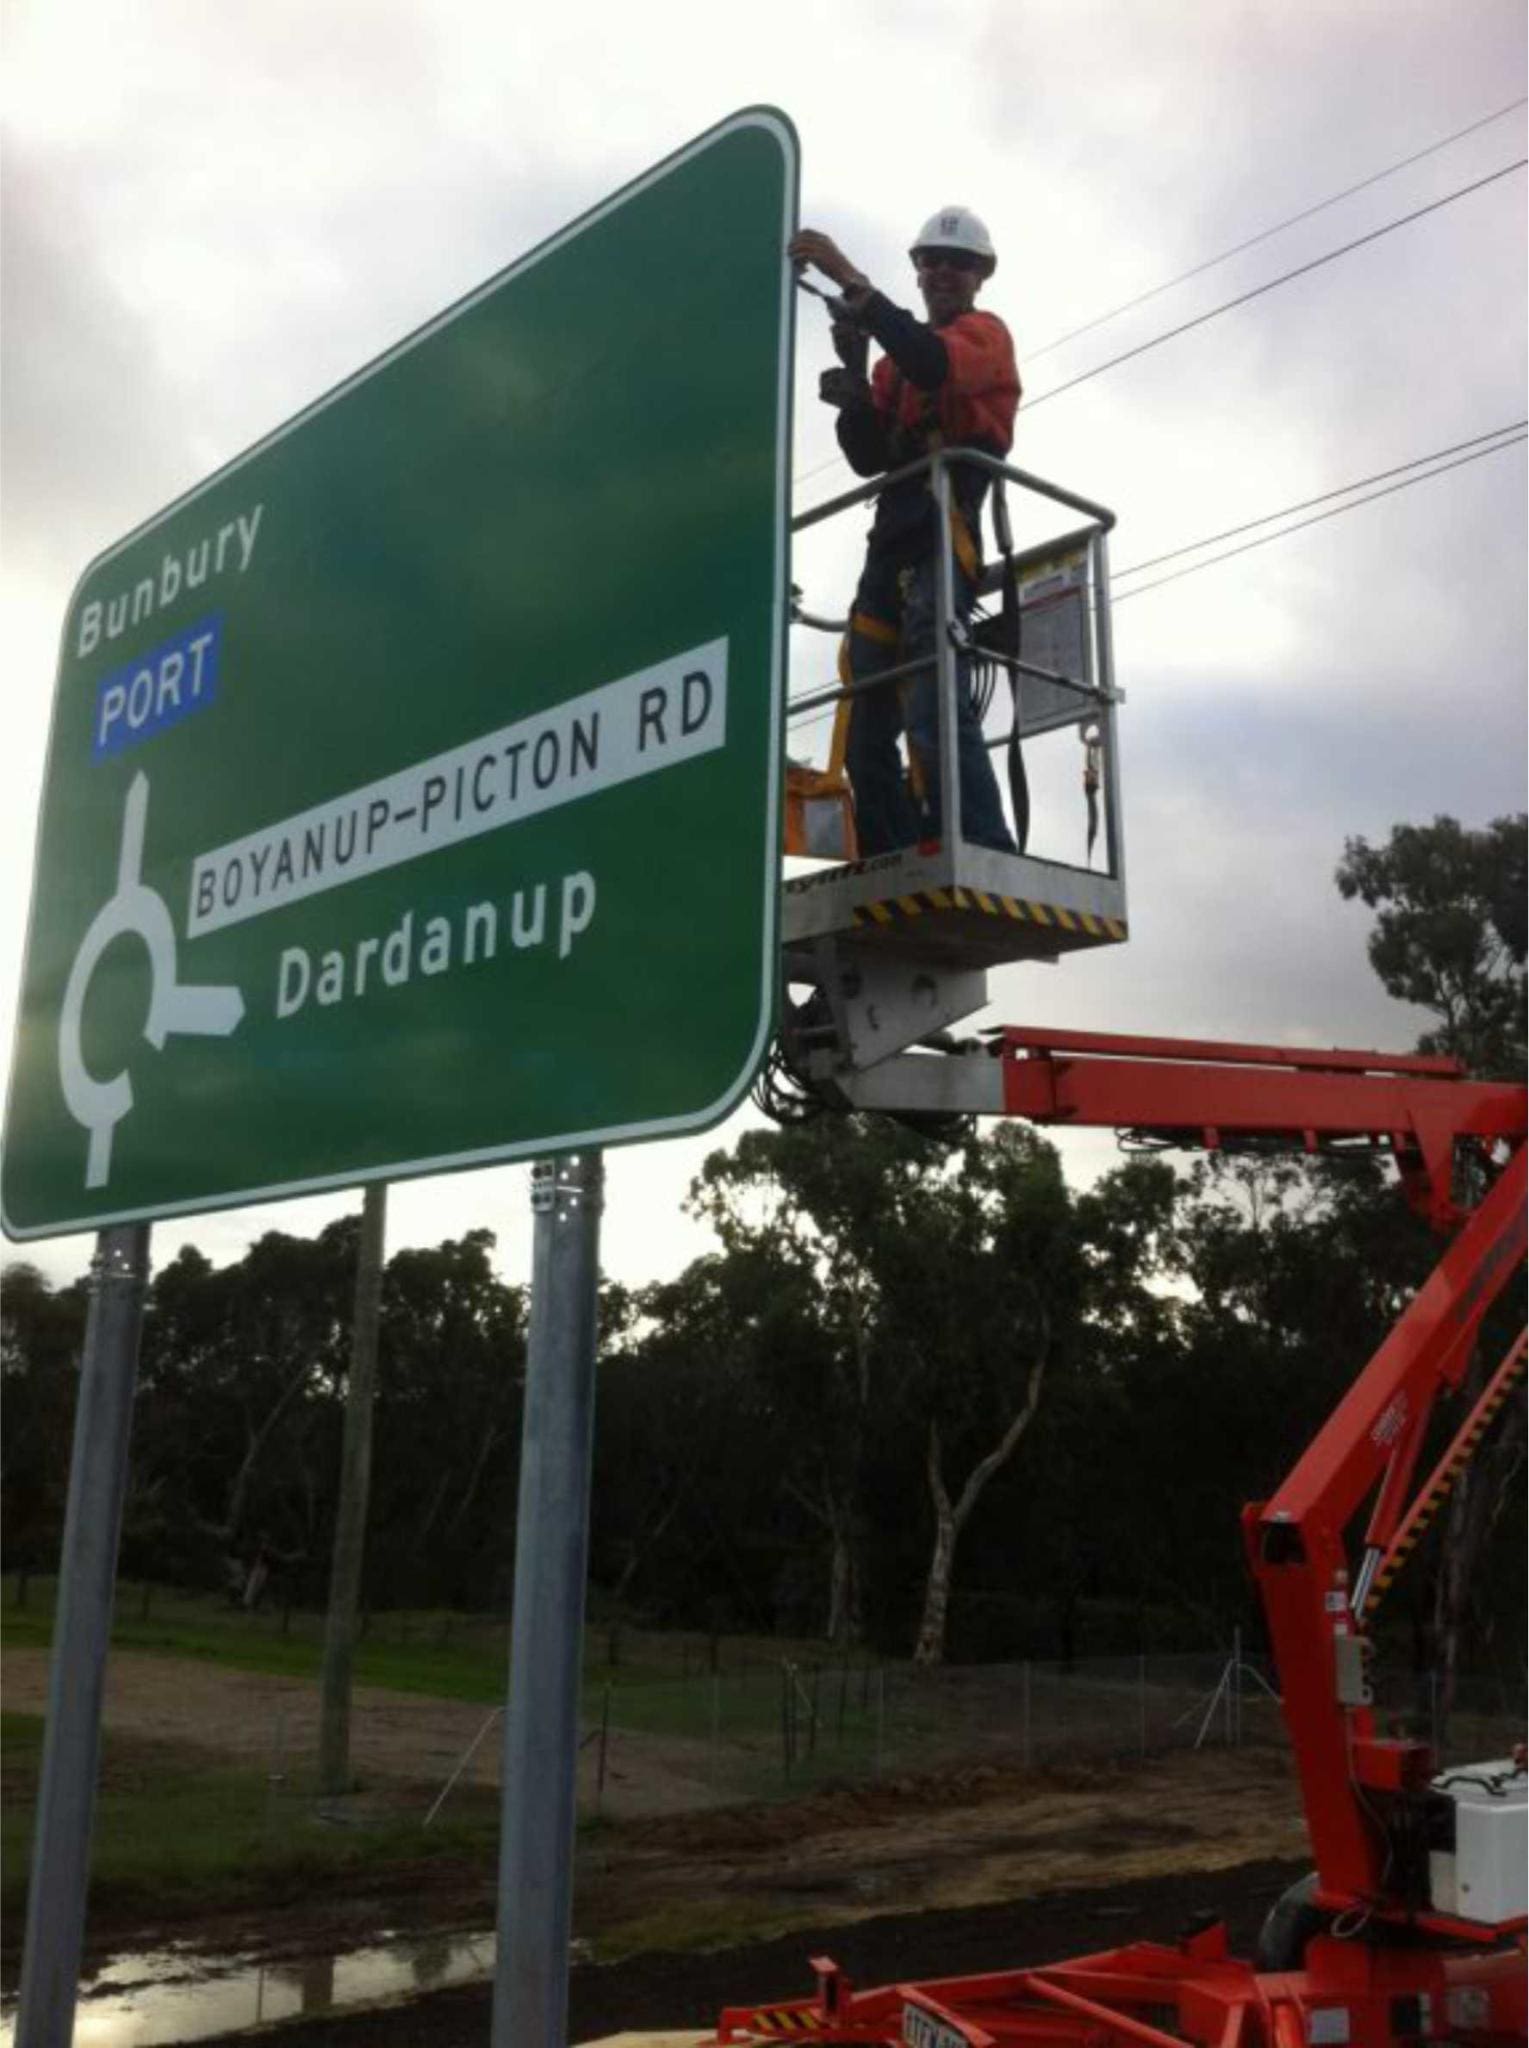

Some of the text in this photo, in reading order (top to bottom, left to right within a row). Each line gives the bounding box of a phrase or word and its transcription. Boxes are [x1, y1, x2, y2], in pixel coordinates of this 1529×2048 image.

[76, 505, 263, 658] Bunbury
[100, 634, 214, 744] PORT
[196, 670, 713, 919] BOYANUP-PICTON RD
[276, 869, 597, 1018] Dardanup
